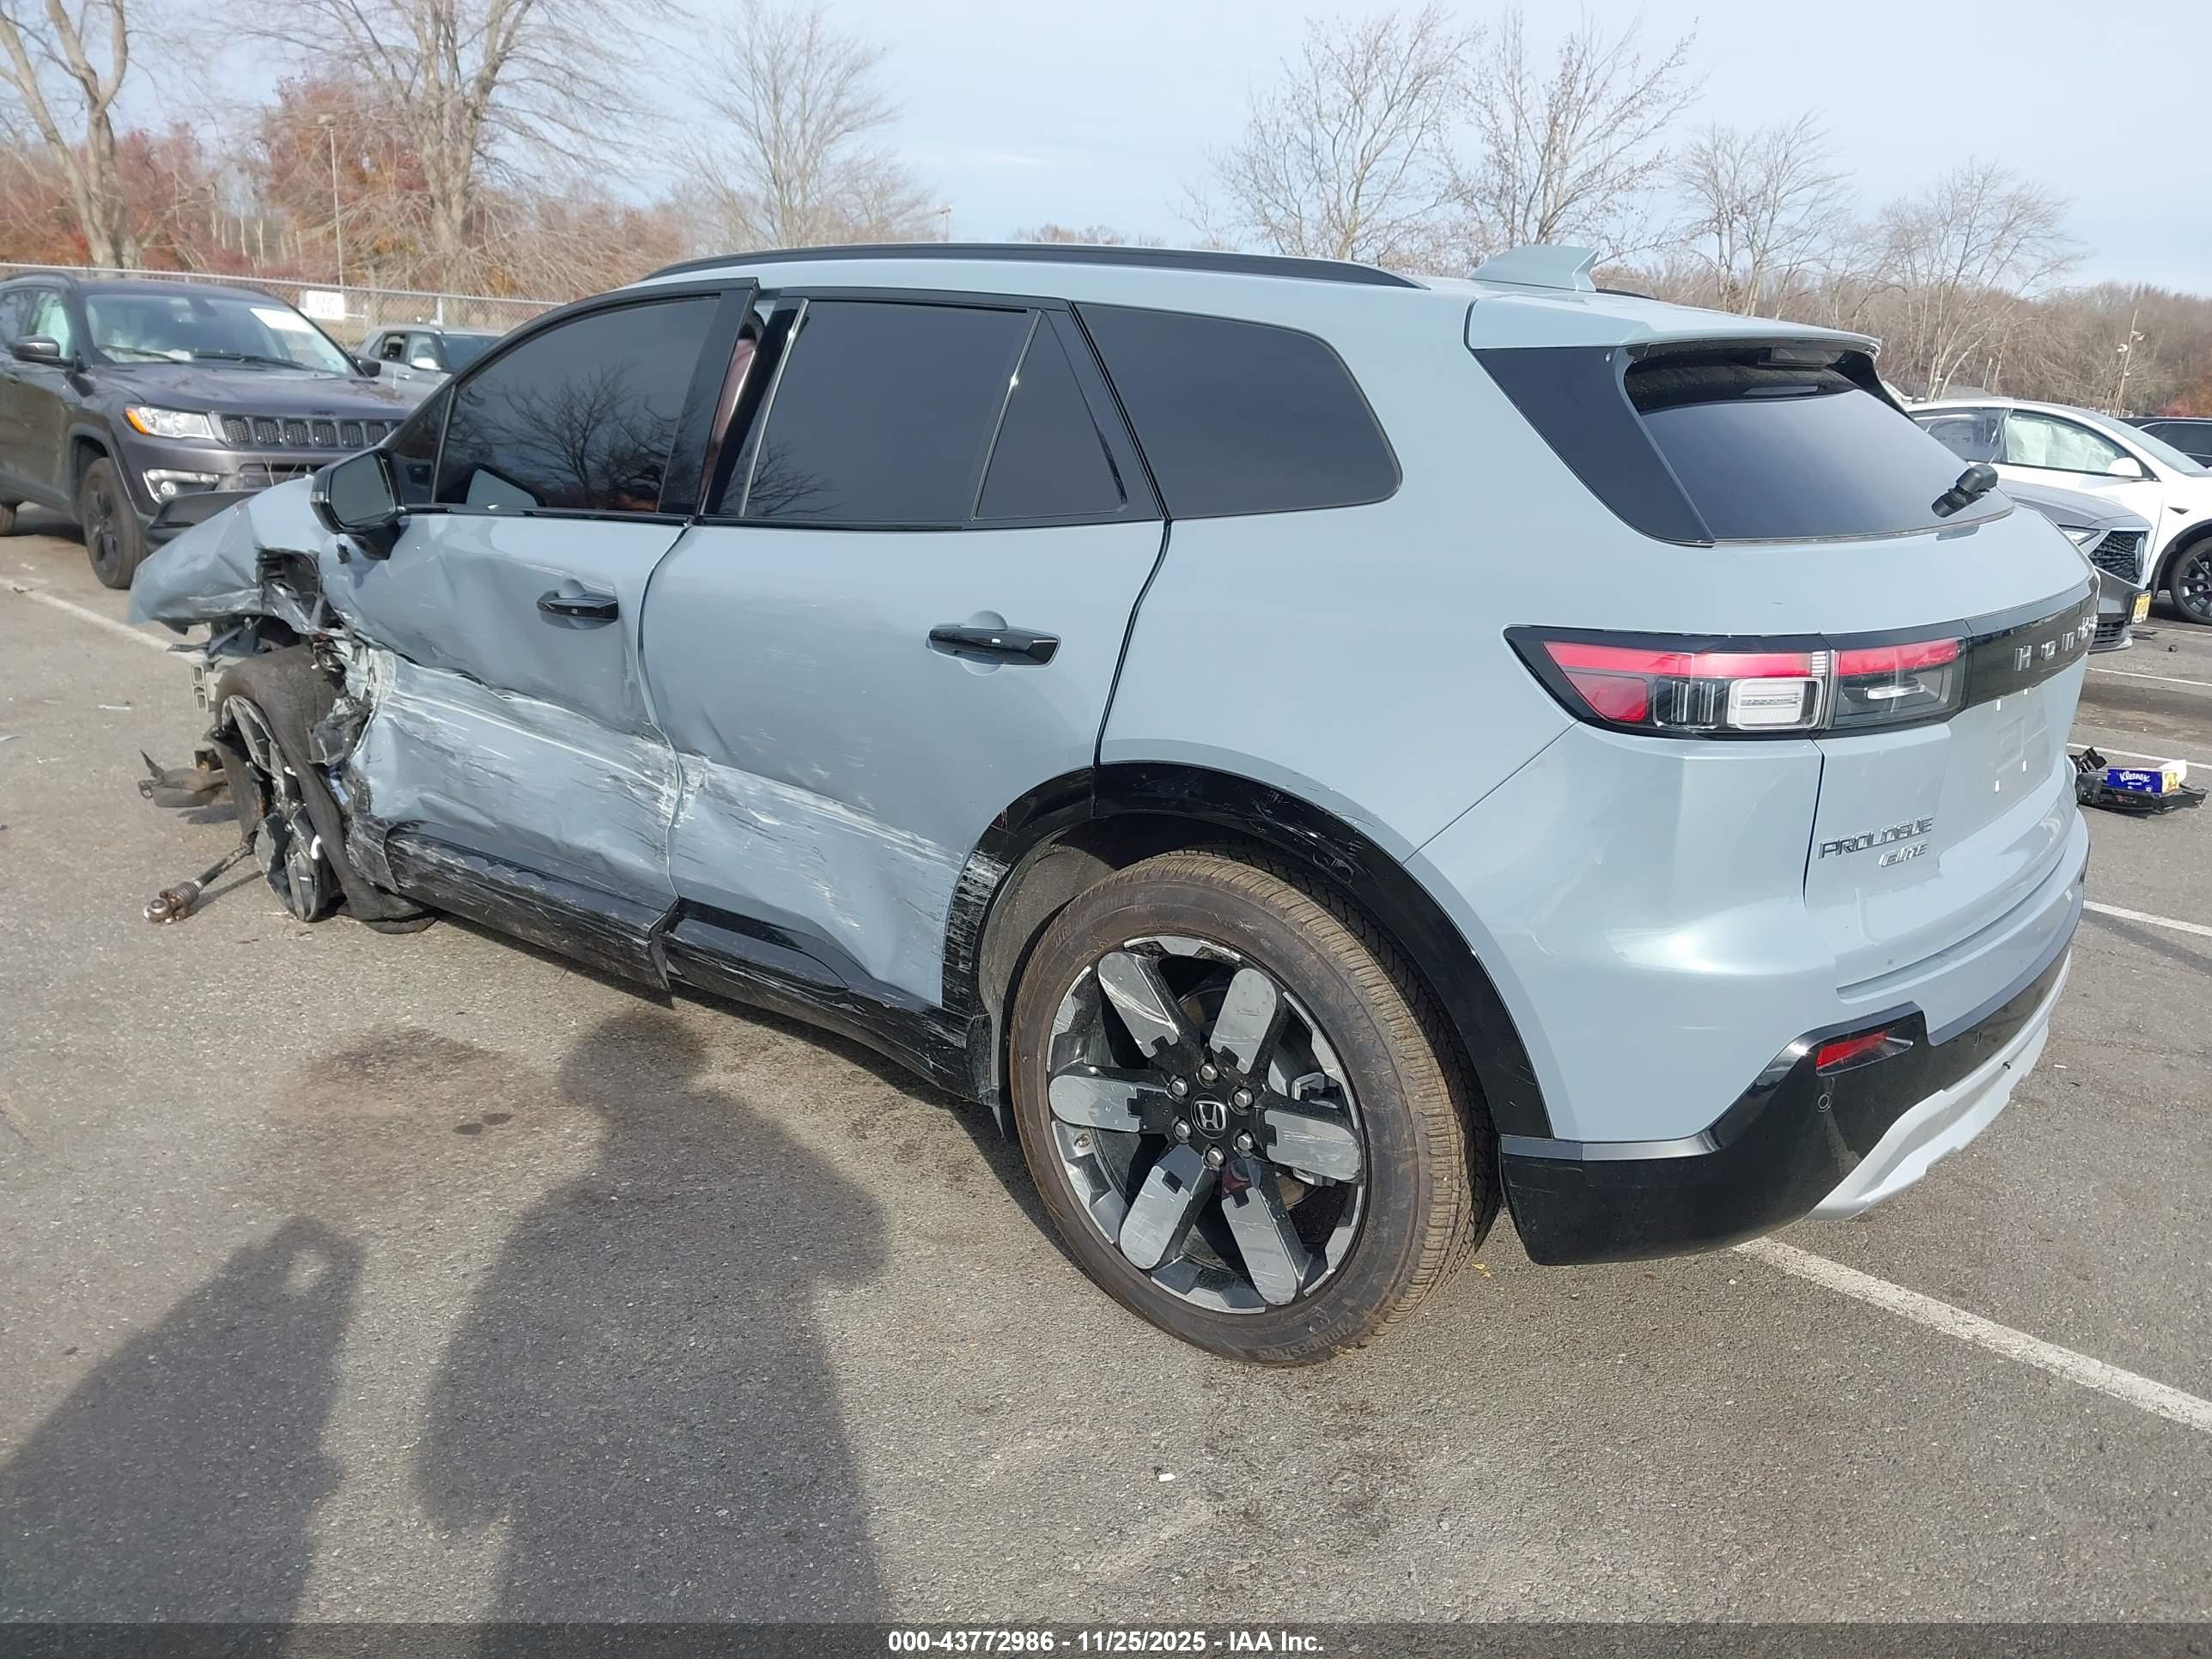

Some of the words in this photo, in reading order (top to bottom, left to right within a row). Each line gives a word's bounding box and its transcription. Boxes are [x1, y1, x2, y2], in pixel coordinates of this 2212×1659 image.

[2118, 770, 2151, 783] Kleenex
[1817, 816, 1934, 860] PROLOGUE
[1878, 841, 1929, 868] ELITE
